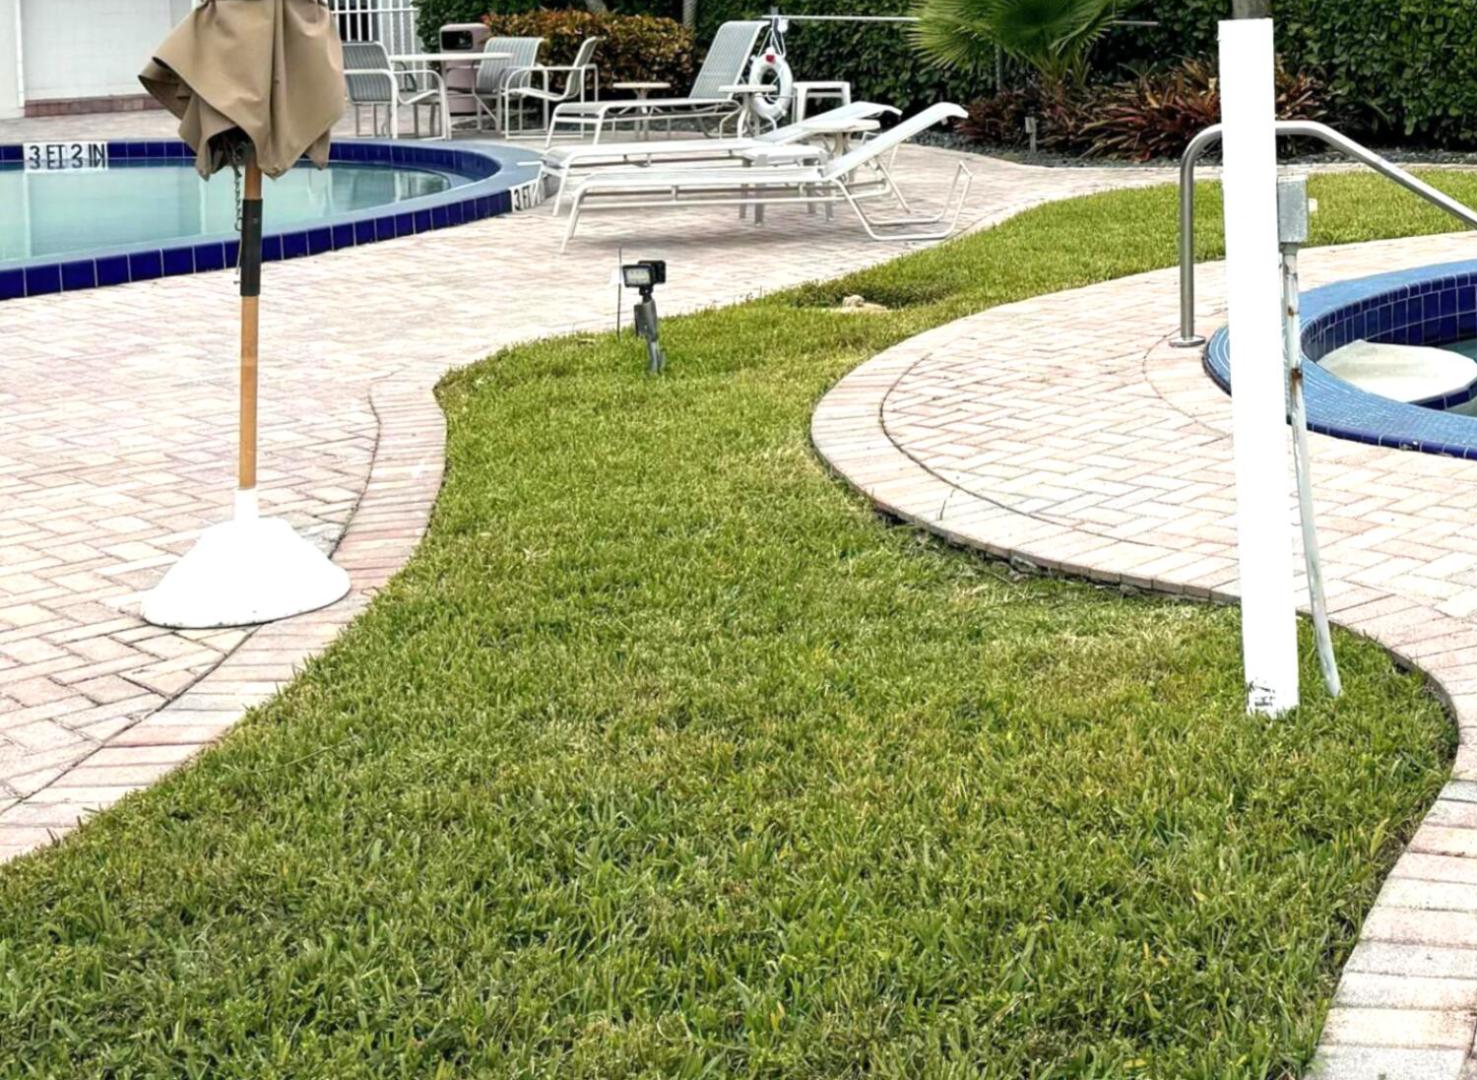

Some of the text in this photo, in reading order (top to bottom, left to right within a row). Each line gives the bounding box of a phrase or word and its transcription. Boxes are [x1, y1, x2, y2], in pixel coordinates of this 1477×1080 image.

[29, 143, 106, 160] 3 FT 2 IN
[514, 188, 521, 211] 3
